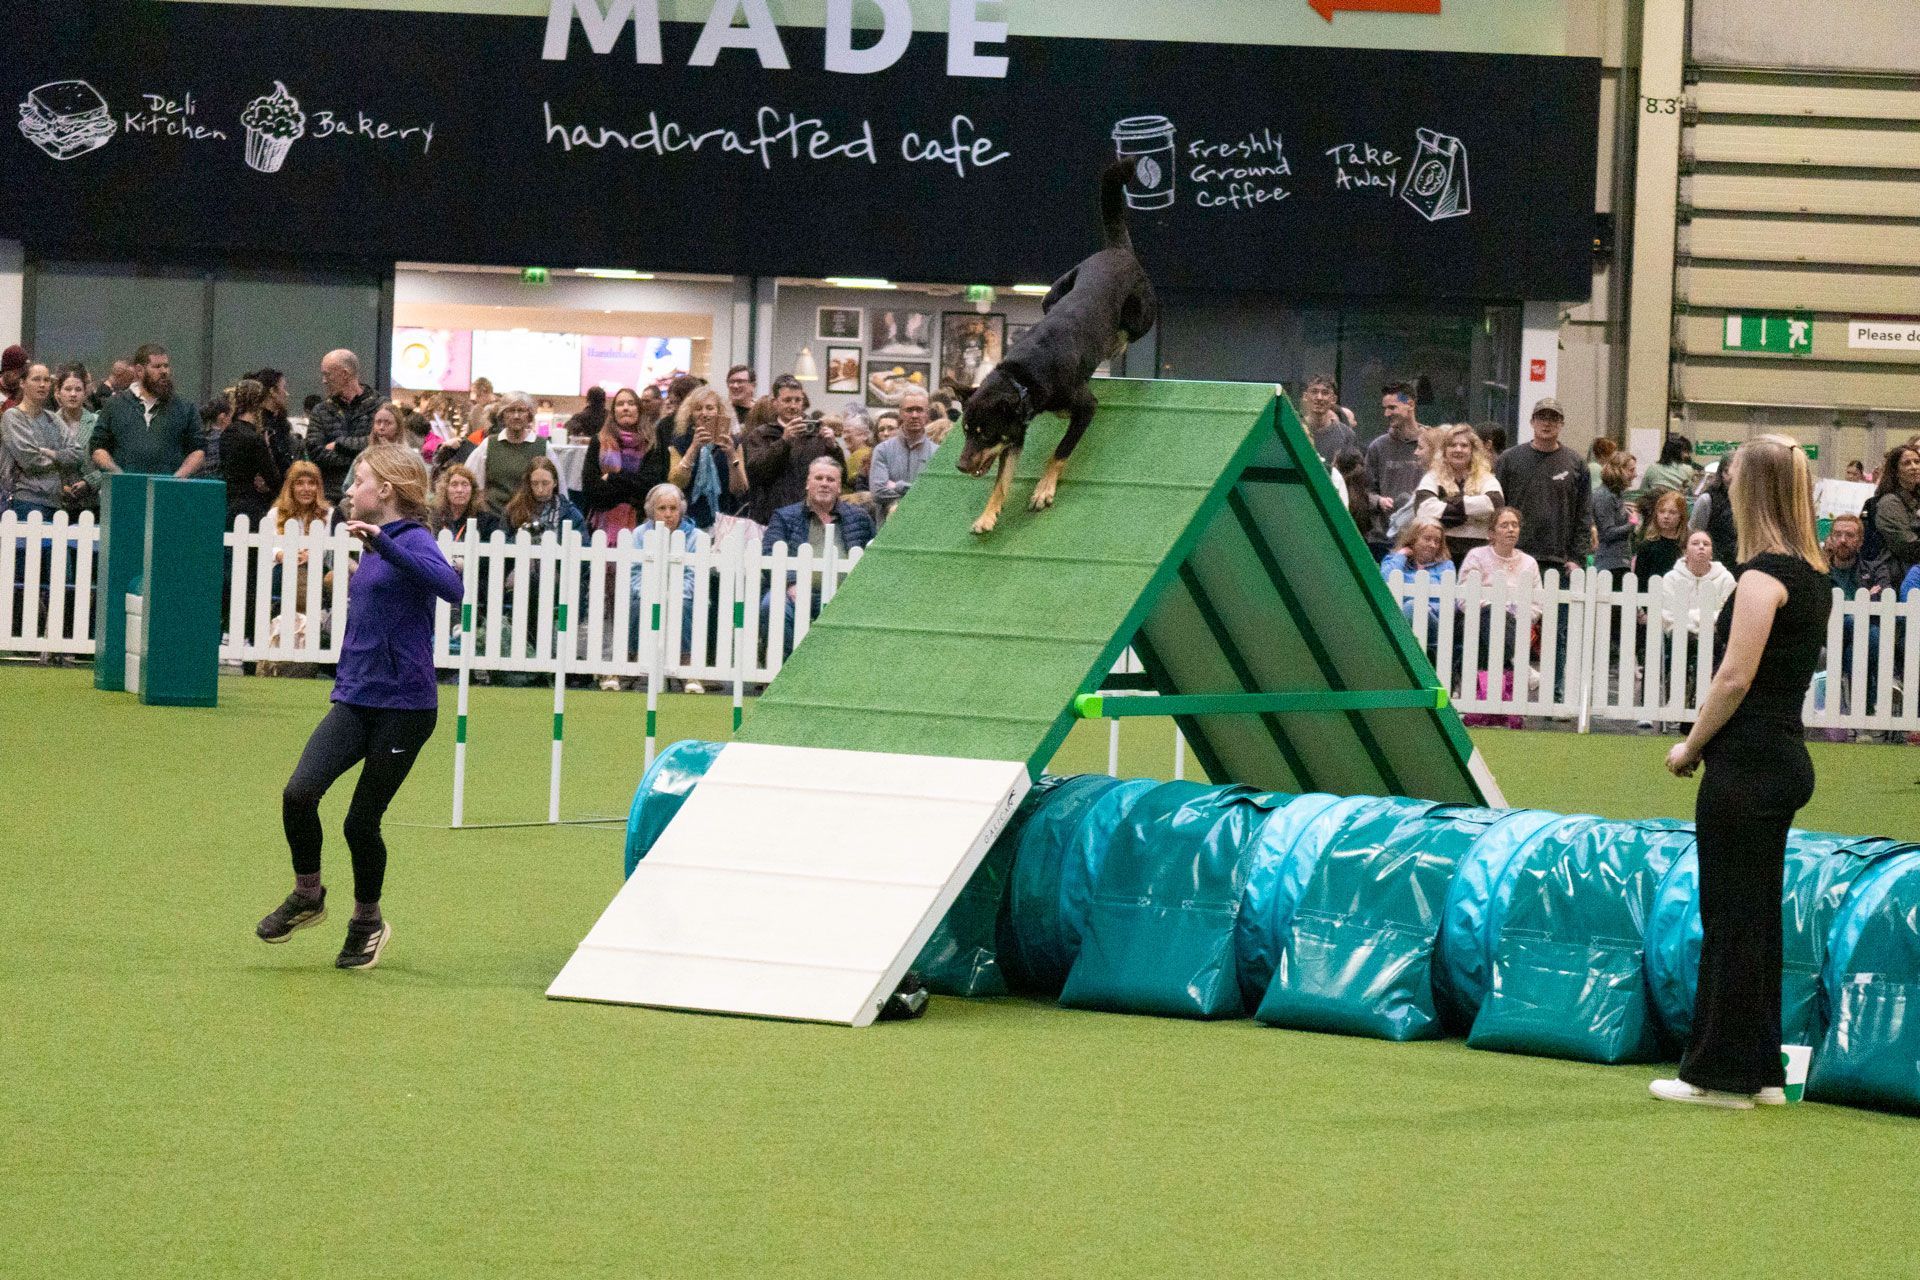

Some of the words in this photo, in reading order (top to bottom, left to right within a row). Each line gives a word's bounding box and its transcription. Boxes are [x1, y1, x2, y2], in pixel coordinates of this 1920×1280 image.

[541, 0, 1010, 78] MADE
[143, 92, 196, 115] Deli
[1646, 97, 1676, 114] 8.3
[124, 108, 228, 141] Kitchen
[312, 109, 434, 154] Bakery
[543, 101, 877, 169] handcrafted
[901, 114, 1011, 179] cafe
[1188, 128, 1284, 158] Freshly
[1325, 142, 1402, 166] Take
[1189, 157, 1292, 184] Ground
[1335, 168, 1397, 198] Away
[1857, 328, 1902, 341] Please
